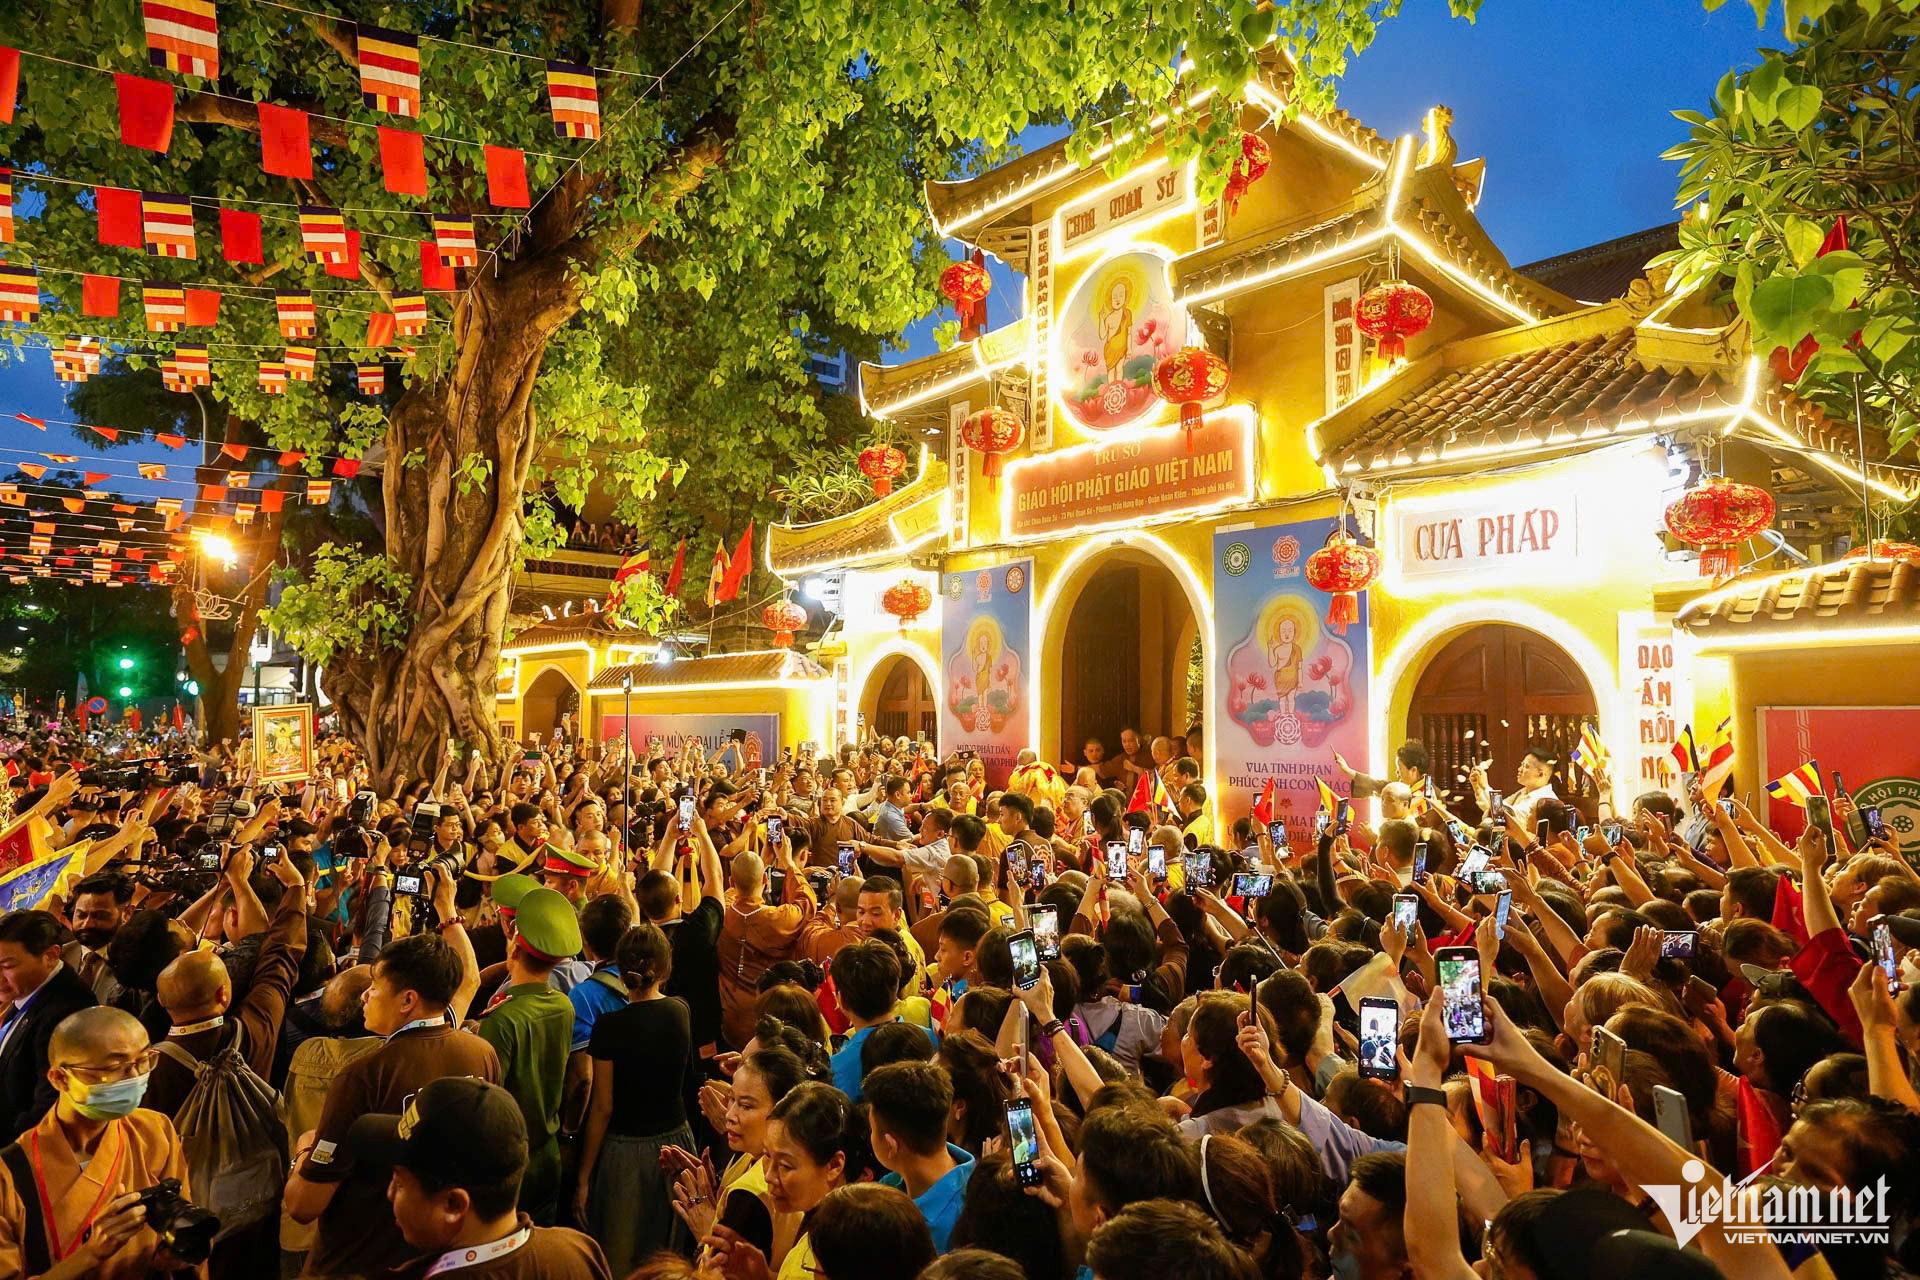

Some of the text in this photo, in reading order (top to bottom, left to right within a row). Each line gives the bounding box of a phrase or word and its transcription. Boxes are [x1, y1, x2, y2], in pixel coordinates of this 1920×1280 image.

[1018, 449, 1233, 512] GIÁO HỘI PHẬT GIÁO VIỆT NAM
[1477, 508, 1559, 557] PHÁP
[1246, 762, 1268, 773] VUA
[1229, 775, 1259, 788] PHÚC
[1261, 777, 1287, 789] SNH
[1290, 778, 1315, 790] CON
[1868, 787, 1892, 802] HỘI
